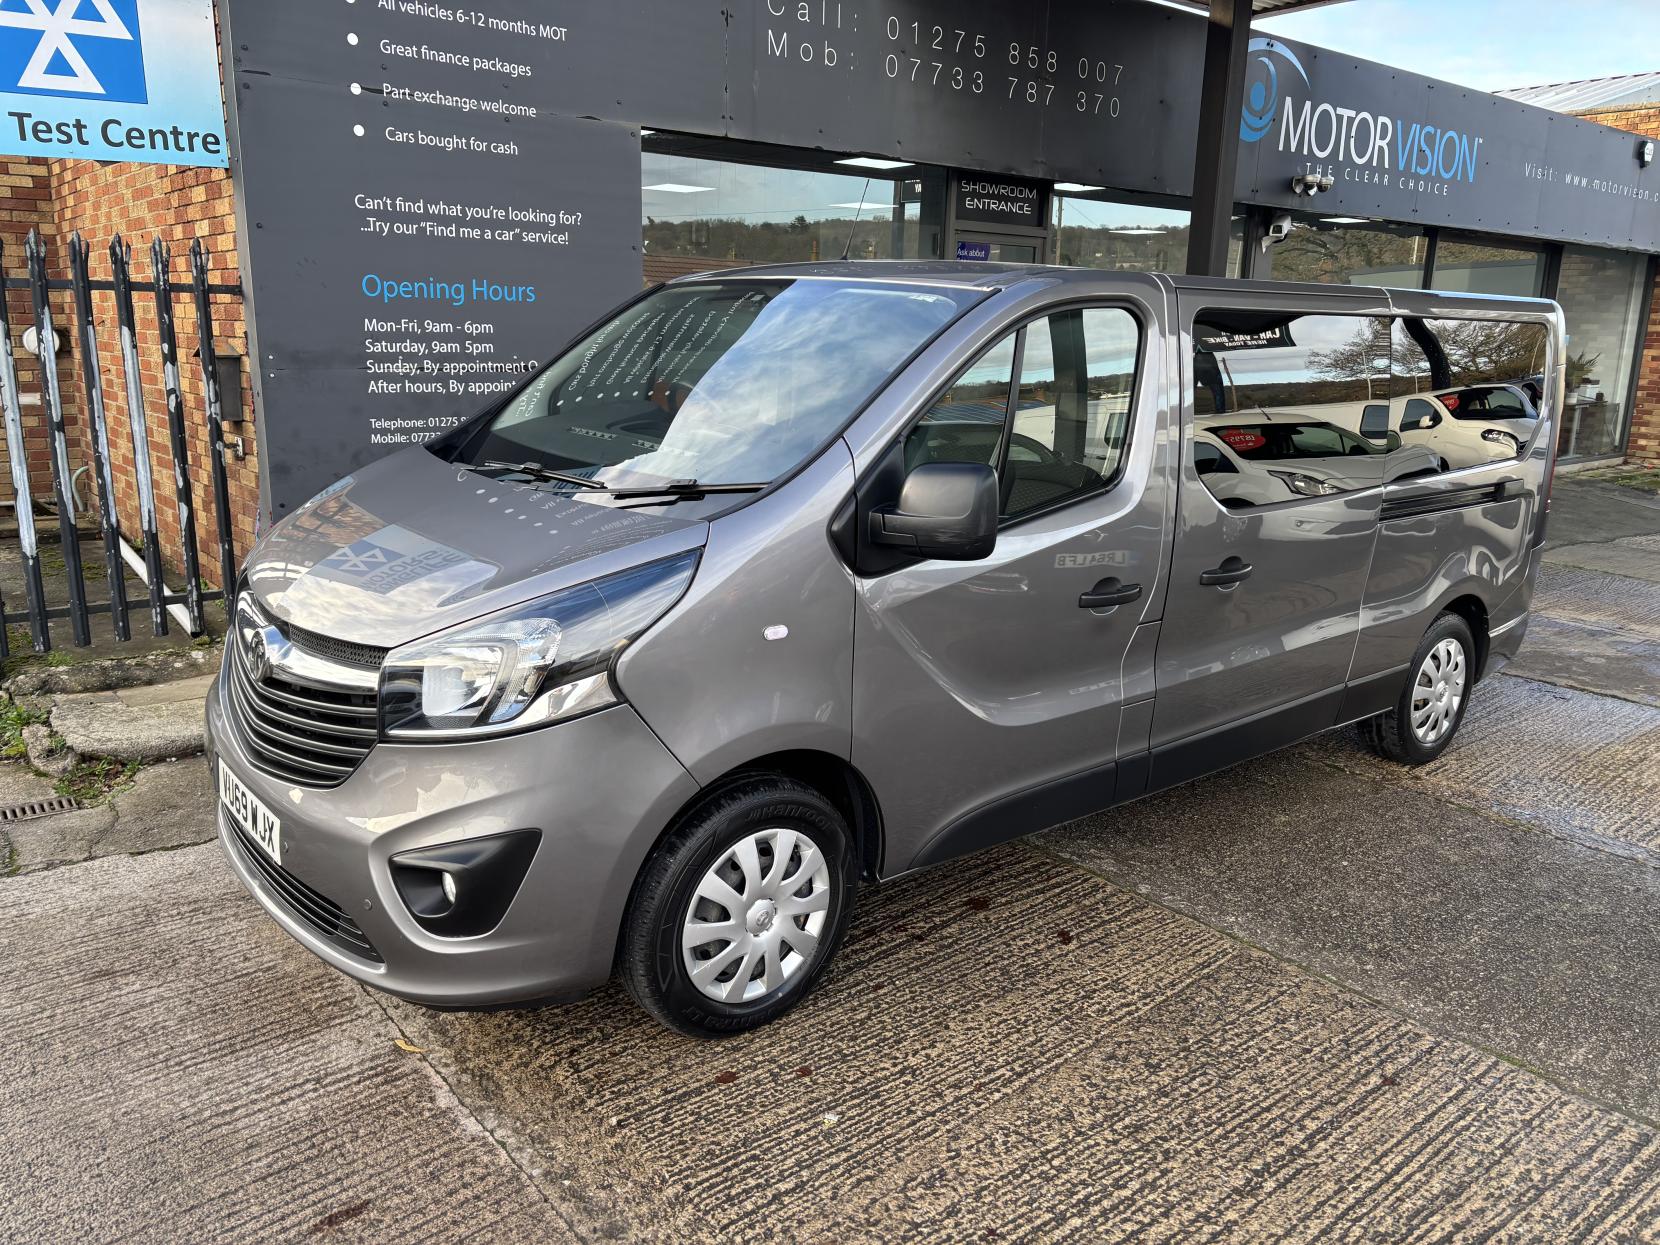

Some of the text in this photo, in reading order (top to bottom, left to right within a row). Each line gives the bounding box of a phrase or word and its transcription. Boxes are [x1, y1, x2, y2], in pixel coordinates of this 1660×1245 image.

[399, 0, 453, 21] vehicles
[456, 9, 486, 27] 6-12
[488, 18, 536, 37] months
[539, 24, 567, 41] MOT
[380, 39, 532, 77] Great finance packages
[886, 16, 986, 58] 01275
[1008, 42, 1058, 73] 858
[1078, 57, 1123, 86] 007
[767, 29, 1120, 118] Mob: 07733 787 370
[383, 83, 537, 118] Part exchange welcome
[8, 111, 221, 155] Test Centre
[385, 127, 519, 156] Cars bought for cash
[1305, 162, 1450, 197] THE CLEAR CHOICE
[1525, 162, 1558, 181] Visit:
[961, 180, 1037, 200] SHOWROOM
[395, 197, 424, 214] find
[427, 201, 463, 217] what
[508, 206, 556, 227] looking
[558, 211, 582, 226] for?
[965, 197, 1032, 215] ENTRANCE
[393, 221, 419, 235] our
[459, 226, 481, 239] me
[483, 229, 492, 240] a
[522, 231, 569, 245] service!
[361, 274, 536, 306] Opening Hours
[364, 318, 421, 335] Mon-Fri,
[424, 320, 453, 333] 9am
[464, 321, 494, 337] 6pm
[365, 339, 494, 356] Saturday, 9am 5pm
[366, 360, 420, 376] Sunday,
[423, 360, 439, 375] By
[443, 360, 525, 376] appointment
[368, 379, 402, 394] After
[405, 380, 446, 396] hours,
[449, 380, 465, 395] By
[369, 418, 427, 430] Telephone:
[428, 417, 459, 427] 01275
[371, 433, 410, 444] Mobile:
[251, 800, 275, 853] WJX
